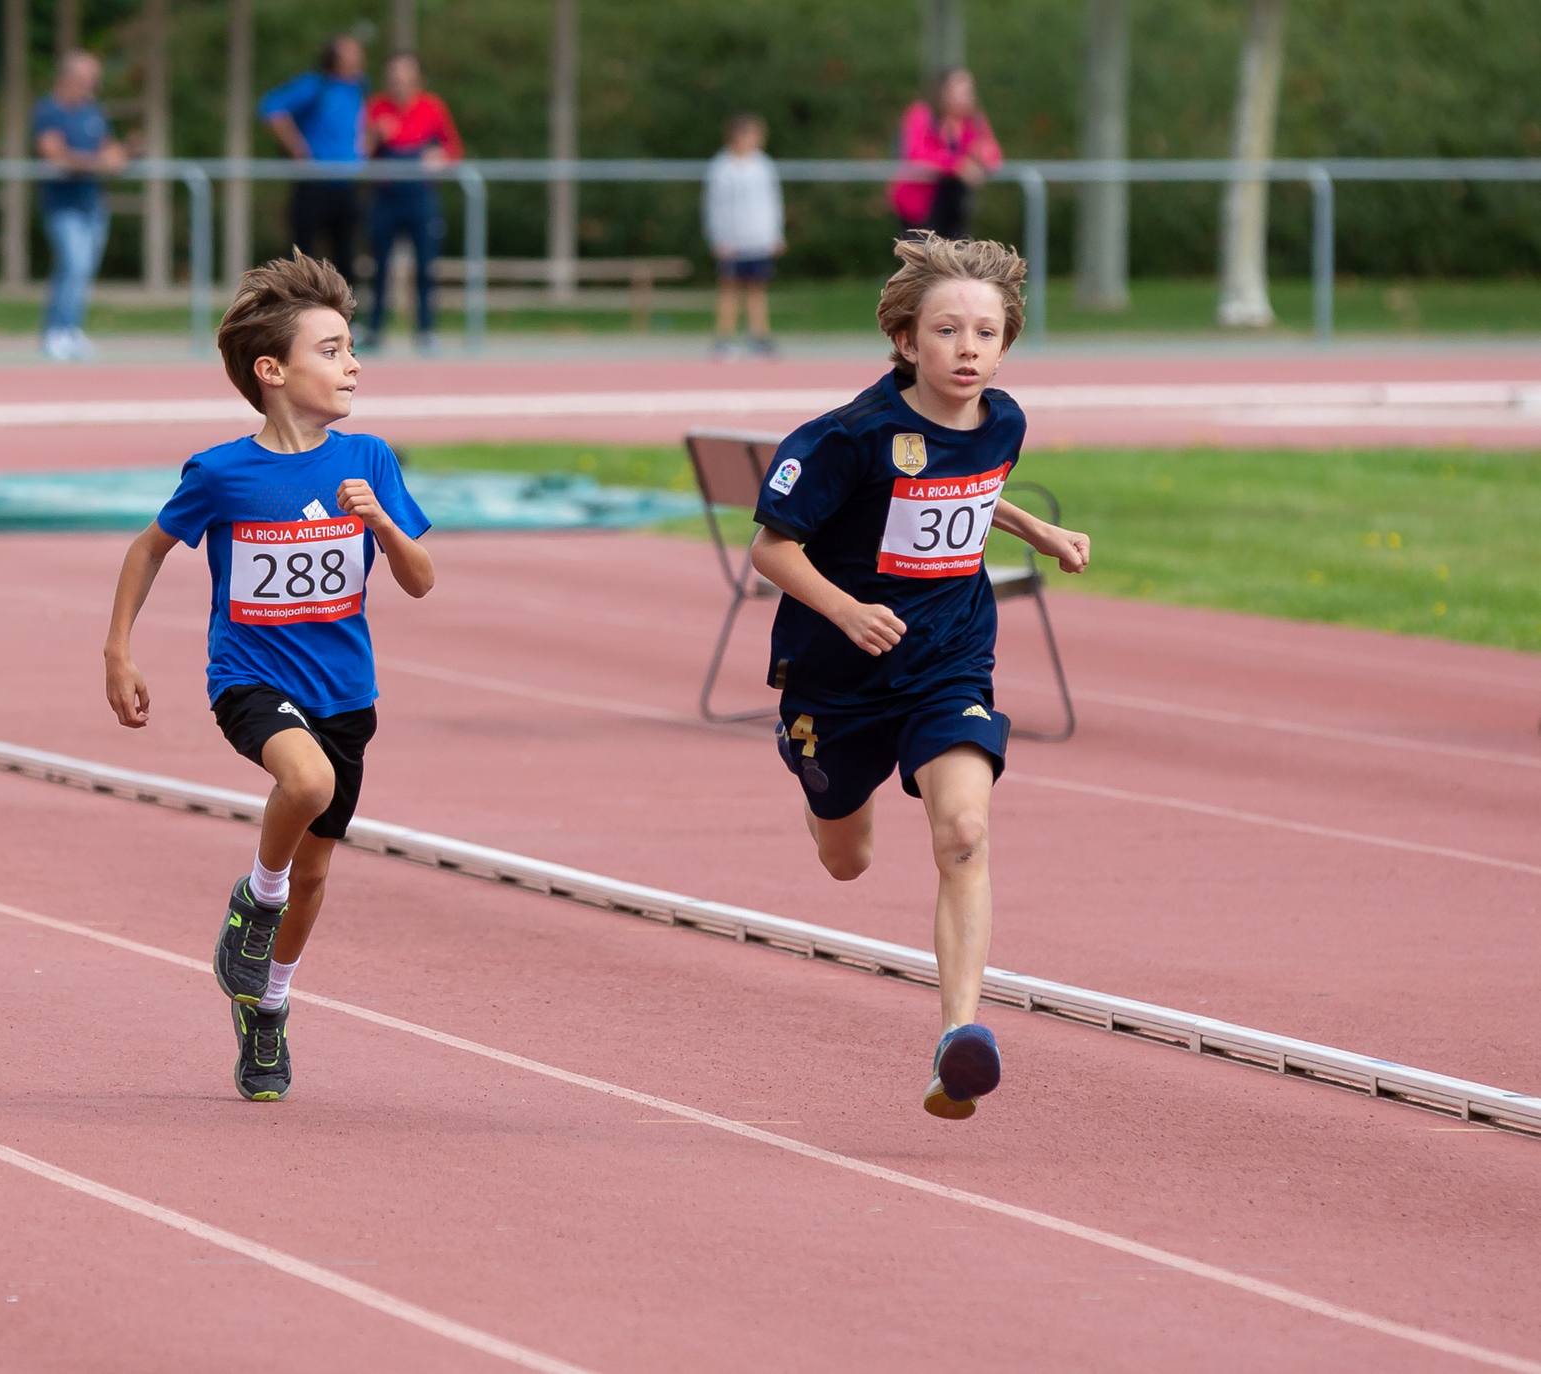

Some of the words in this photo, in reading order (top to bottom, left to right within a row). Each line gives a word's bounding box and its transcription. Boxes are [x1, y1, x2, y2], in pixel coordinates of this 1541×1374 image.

[909, 486, 925, 498] LA
[928, 485, 962, 498] RIOJA
[241, 527, 253, 540] LA
[256, 529, 293, 541] RIOJA
[296, 523, 355, 540] ATLETISMO
[913, 500, 995, 552] 307
[252, 549, 346, 599] 288
[241, 602, 353, 619] www.lariojaatletismo.com
[790, 713, 819, 758] 4
